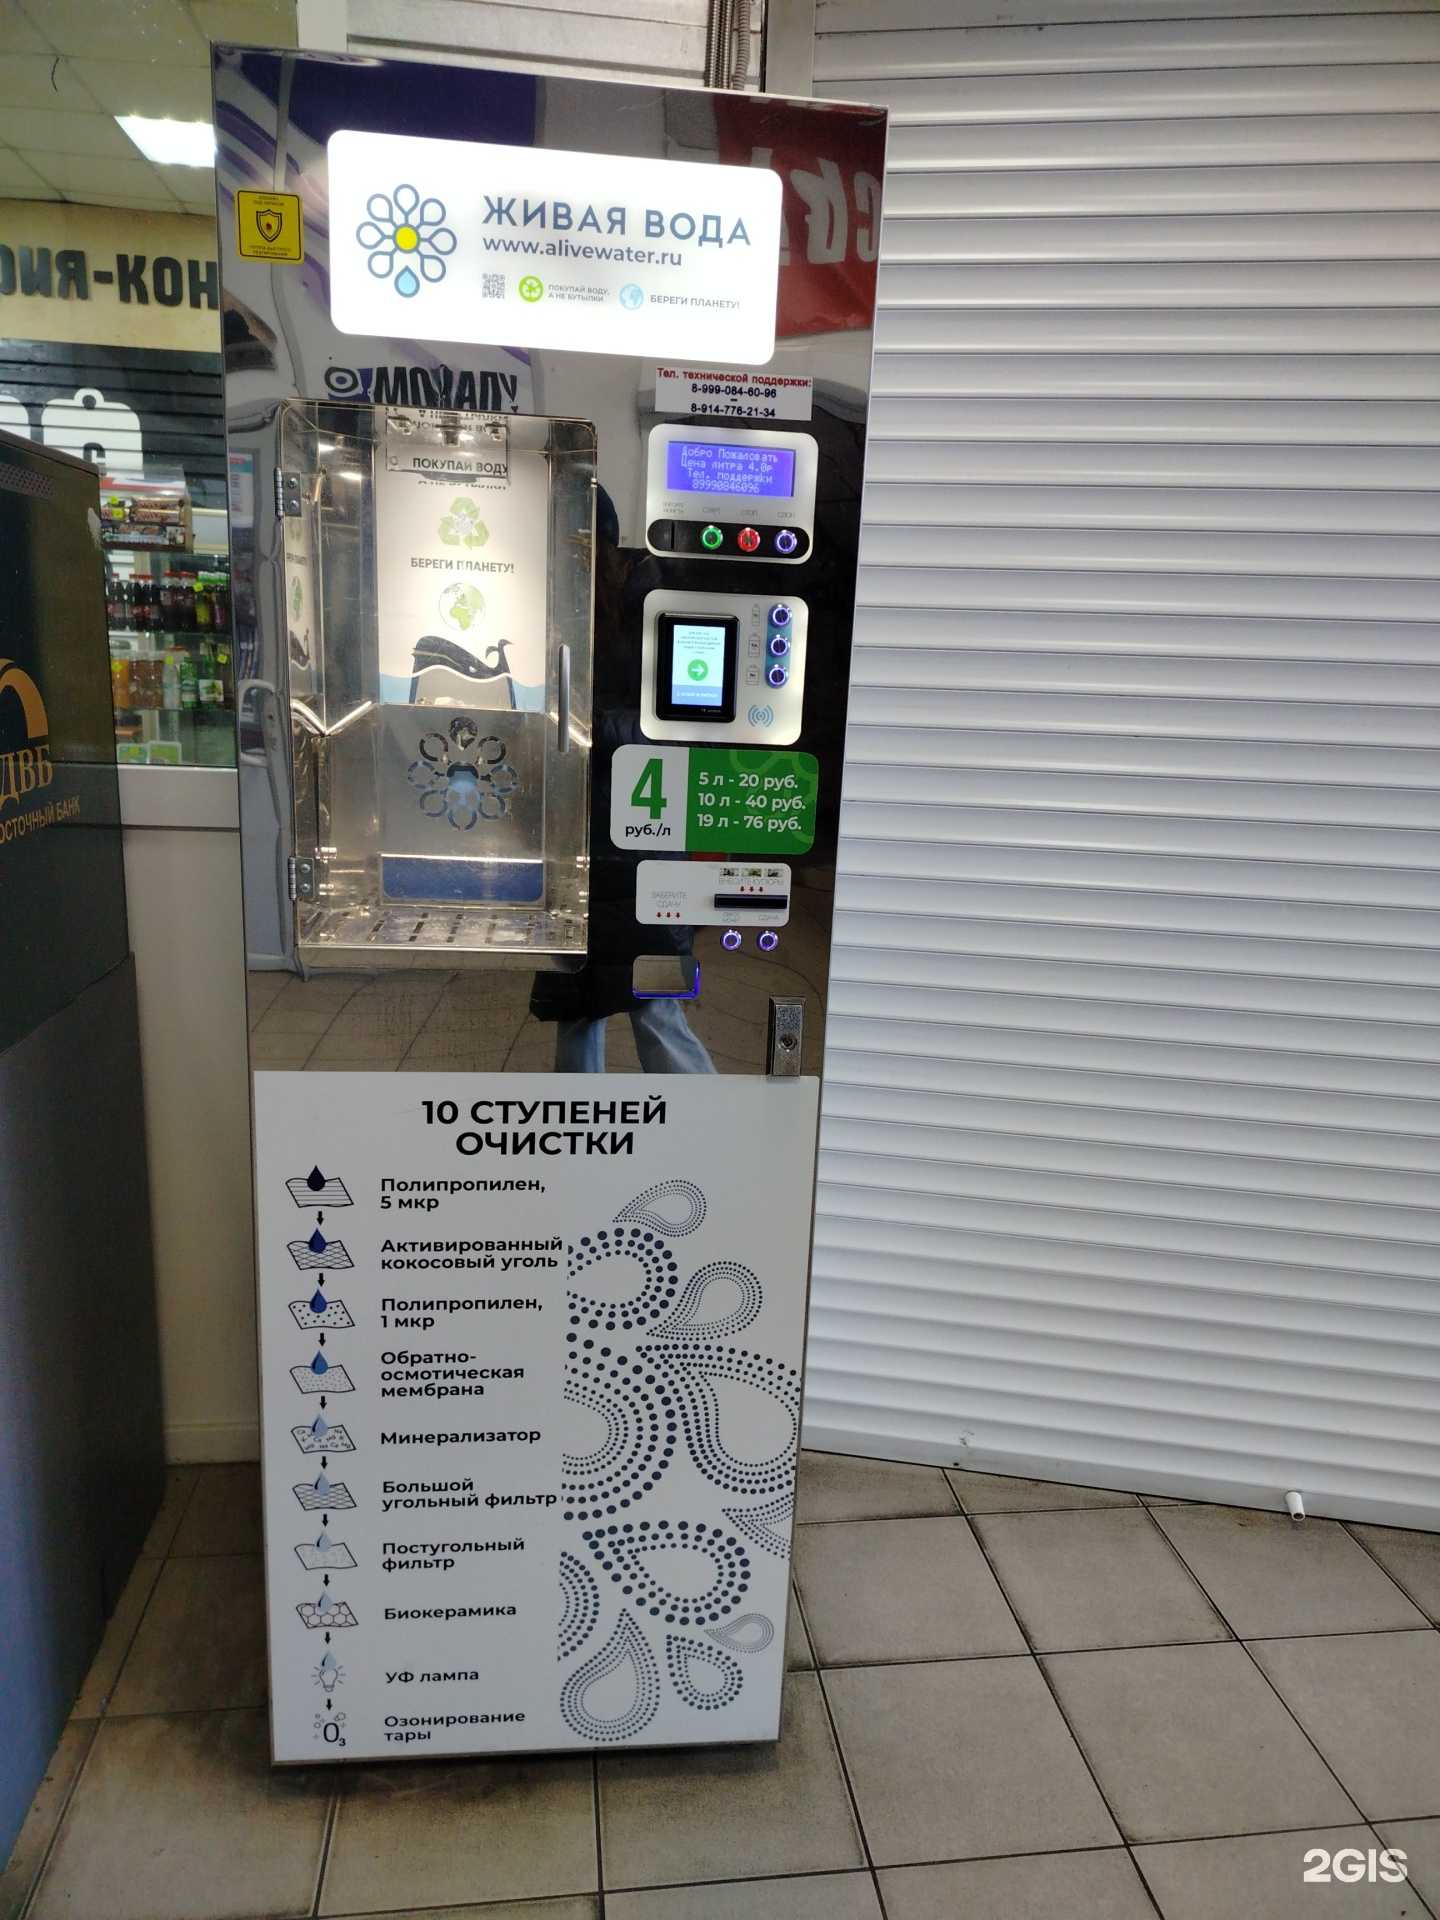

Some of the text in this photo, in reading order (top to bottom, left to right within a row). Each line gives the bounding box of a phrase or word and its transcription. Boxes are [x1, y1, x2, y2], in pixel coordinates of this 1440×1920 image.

[483, 195, 751, 248] ЖИВАЯ ВОДА
[482, 237, 682, 266] www.alivewater.ru
[548, 284, 586, 294] ПОКУПАЙ
[650, 295, 740, 309] БЕРЕГИ ПЛАНЕТУ!
[656, 368, 812, 388] Тел. технической поддержки:
[691, 383, 777, 398] 8-999-084-60-96
[690, 403, 776, 417] 8-914-776-21-34
[681, 446, 778, 463] Добро Пожаловать
[681, 455, 706, 468] Цена
[712, 461, 743, 471] литра
[688, 468, 773, 483] Тел. поддержки
[410, 557, 515, 574] БЕРЕГИ ПЛАНЕТУ!
[630, 758, 668, 820] 4
[699, 772, 709, 785] 5
[712, 775, 724, 786] л
[738, 774, 759, 787] 20
[764, 774, 798, 791] руб.
[698, 793, 715, 806] 10
[719, 796, 730, 807] л
[745, 795, 767, 808] 40
[772, 796, 806, 812] руб.
[625, 824, 671, 838] руб./л
[697, 814, 714, 827] 19
[717, 816, 729, 828] л
[743, 816, 764, 829] 76
[768, 815, 802, 833] руб.
[421, 1094, 667, 1125] 10 СТУПЕНЕЙ
[455, 1131, 634, 1156] ОЧИСТКИ
[381, 1178, 546, 1195] Полипропилен,
[380, 1195, 439, 1212] 5 мкр
[380, 1236, 563, 1255] Активированный
[381, 1254, 558, 1272] кокосовый уголь
[381, 1298, 543, 1314] Полипропилен,
[380, 1315, 435, 1331] 1 мкр
[380, 1350, 477, 1366] Обратно-
[380, 1368, 524, 1381] осмотическая
[381, 1382, 484, 1400] мембрана
[380, 1430, 541, 1447] Минерализатор
[383, 1478, 474, 1494] Большой
[382, 1493, 557, 1512] угольный фильтр
[383, 1537, 525, 1557] Постугольный
[382, 1557, 455, 1573] фильтр
[384, 1606, 517, 1621] Биокерамика
[386, 1671, 479, 1684] УФ лампа
[384, 1712, 526, 1728] Озонирование
[385, 1731, 431, 1744] тары
